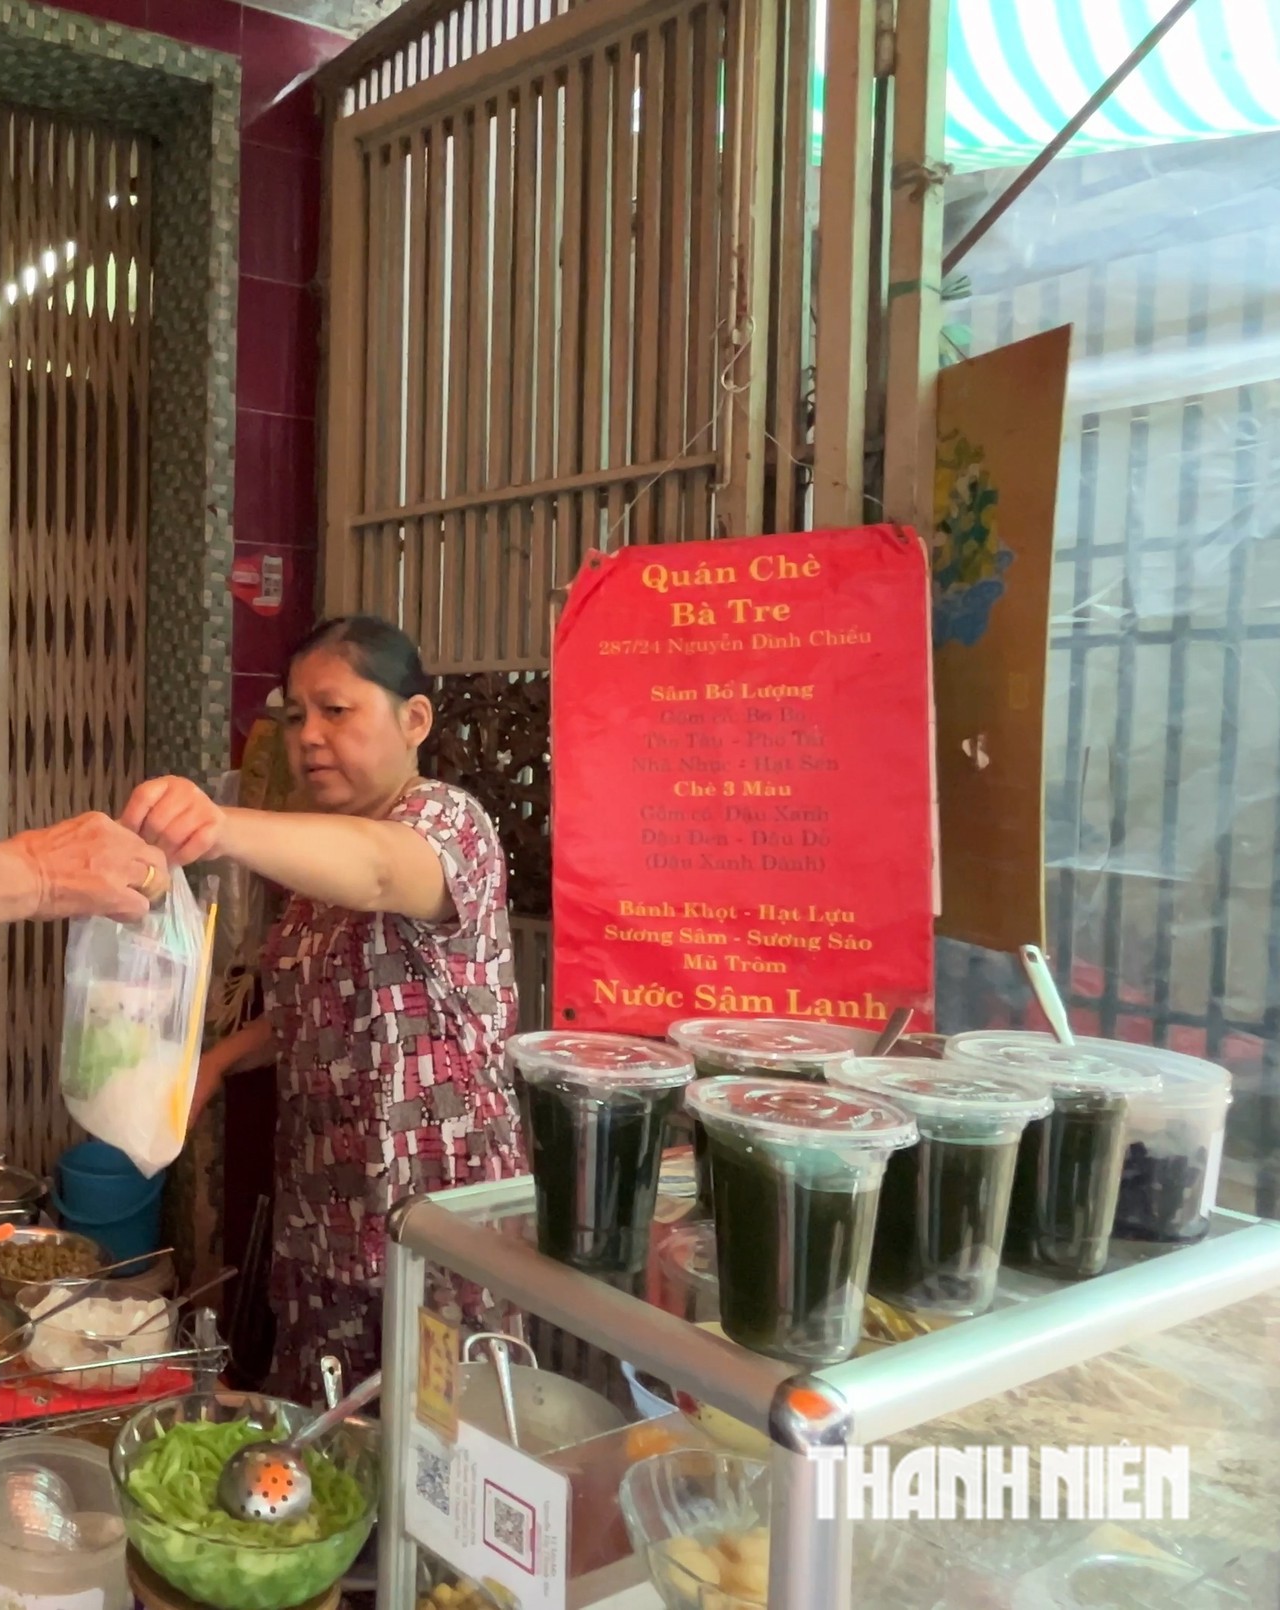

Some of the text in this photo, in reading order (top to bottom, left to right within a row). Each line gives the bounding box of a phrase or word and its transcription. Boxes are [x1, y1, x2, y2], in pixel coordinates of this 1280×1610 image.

[642, 553, 821, 593] Quán Chè
[671, 598, 791, 627] Bà Tre
[651, 685, 698, 702] Sâm
[741, 683, 815, 703] Lượng
[723, 781, 735, 797] 3
[758, 904, 802, 925] Hạt
[679, 927, 728, 945] Sâm
[724, 955, 787, 973] Trôm
[786, 988, 888, 1024] Lạnh
